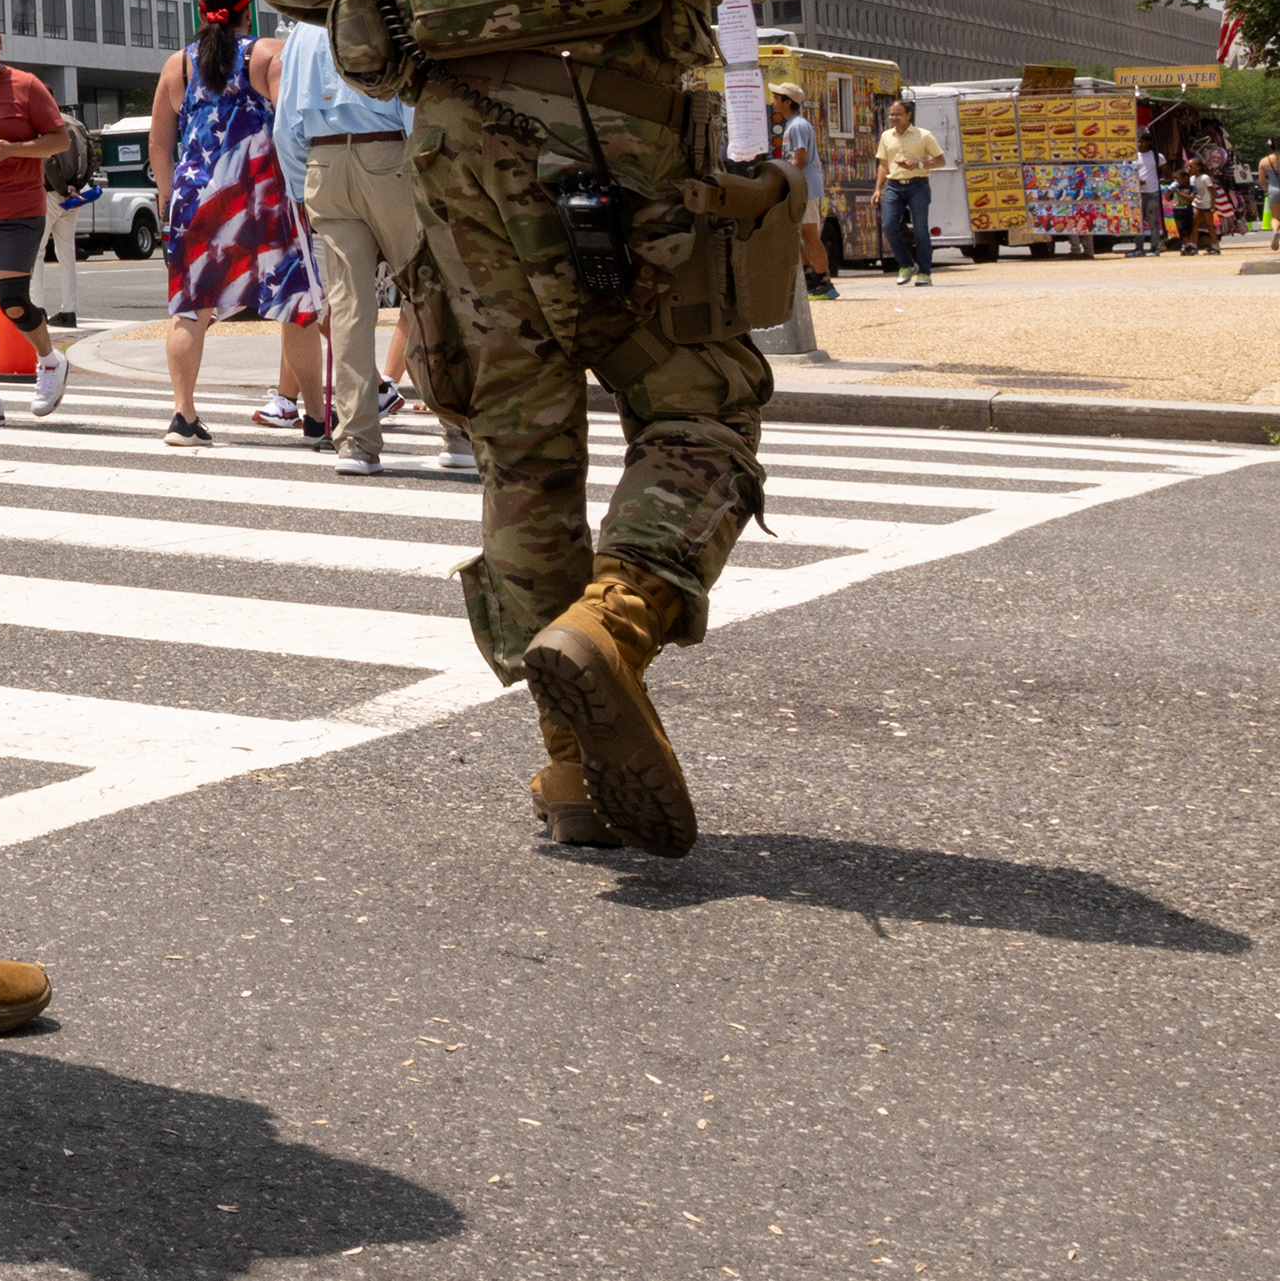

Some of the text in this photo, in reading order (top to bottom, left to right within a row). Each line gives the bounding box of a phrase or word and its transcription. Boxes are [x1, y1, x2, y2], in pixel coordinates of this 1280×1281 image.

[1120, 72, 1217, 84] ICE COLD WATER
